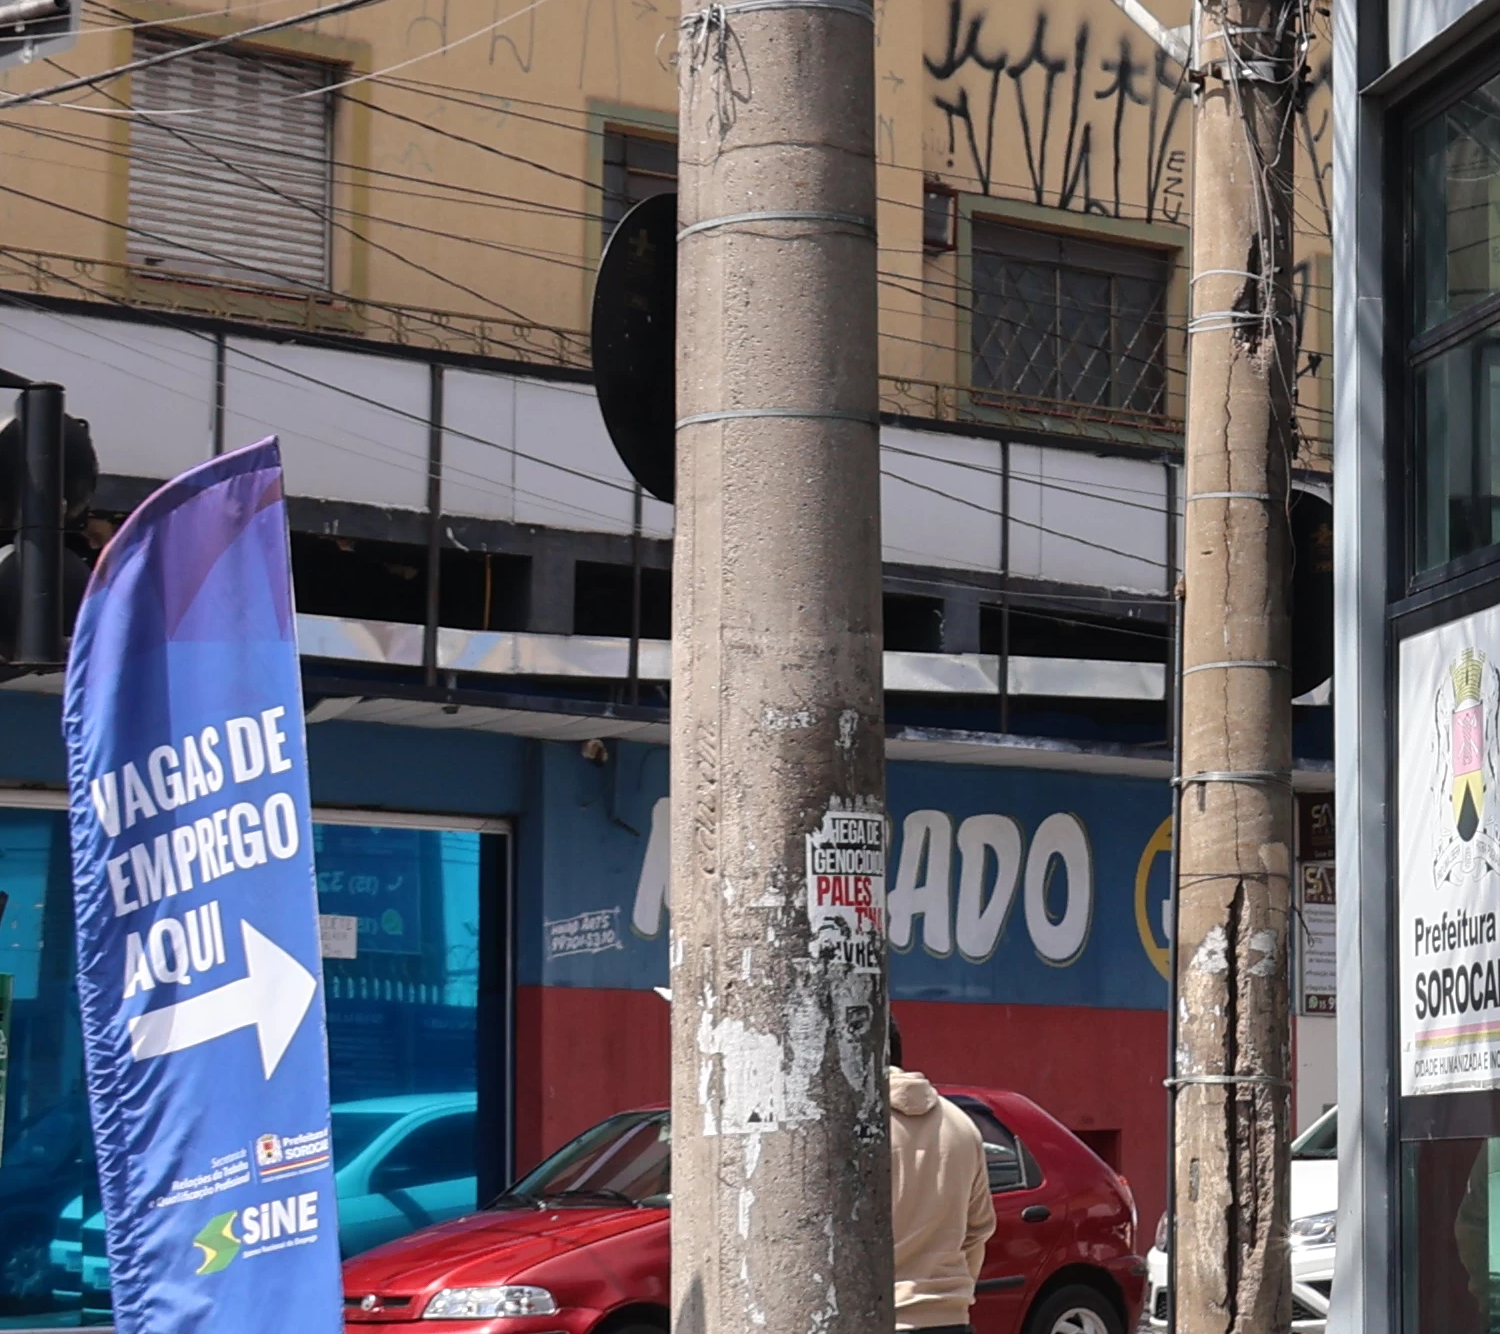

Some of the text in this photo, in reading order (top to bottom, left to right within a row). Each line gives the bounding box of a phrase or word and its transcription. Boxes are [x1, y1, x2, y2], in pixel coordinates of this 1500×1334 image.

[89, 705, 293, 838] VAGAS DE
[105, 792, 299, 919] EMPREGO
[830, 819, 867, 845] HEGA
[816, 876, 873, 907] PALES
[123, 899, 227, 1002] AQUI
[1415, 908, 1496, 956] Prefeitura
[1414, 1058, 1438, 1078] CIDADE
[1440, 1053, 1483, 1075] HUMANIZADA
[1483, 1052, 1489, 1070] E
